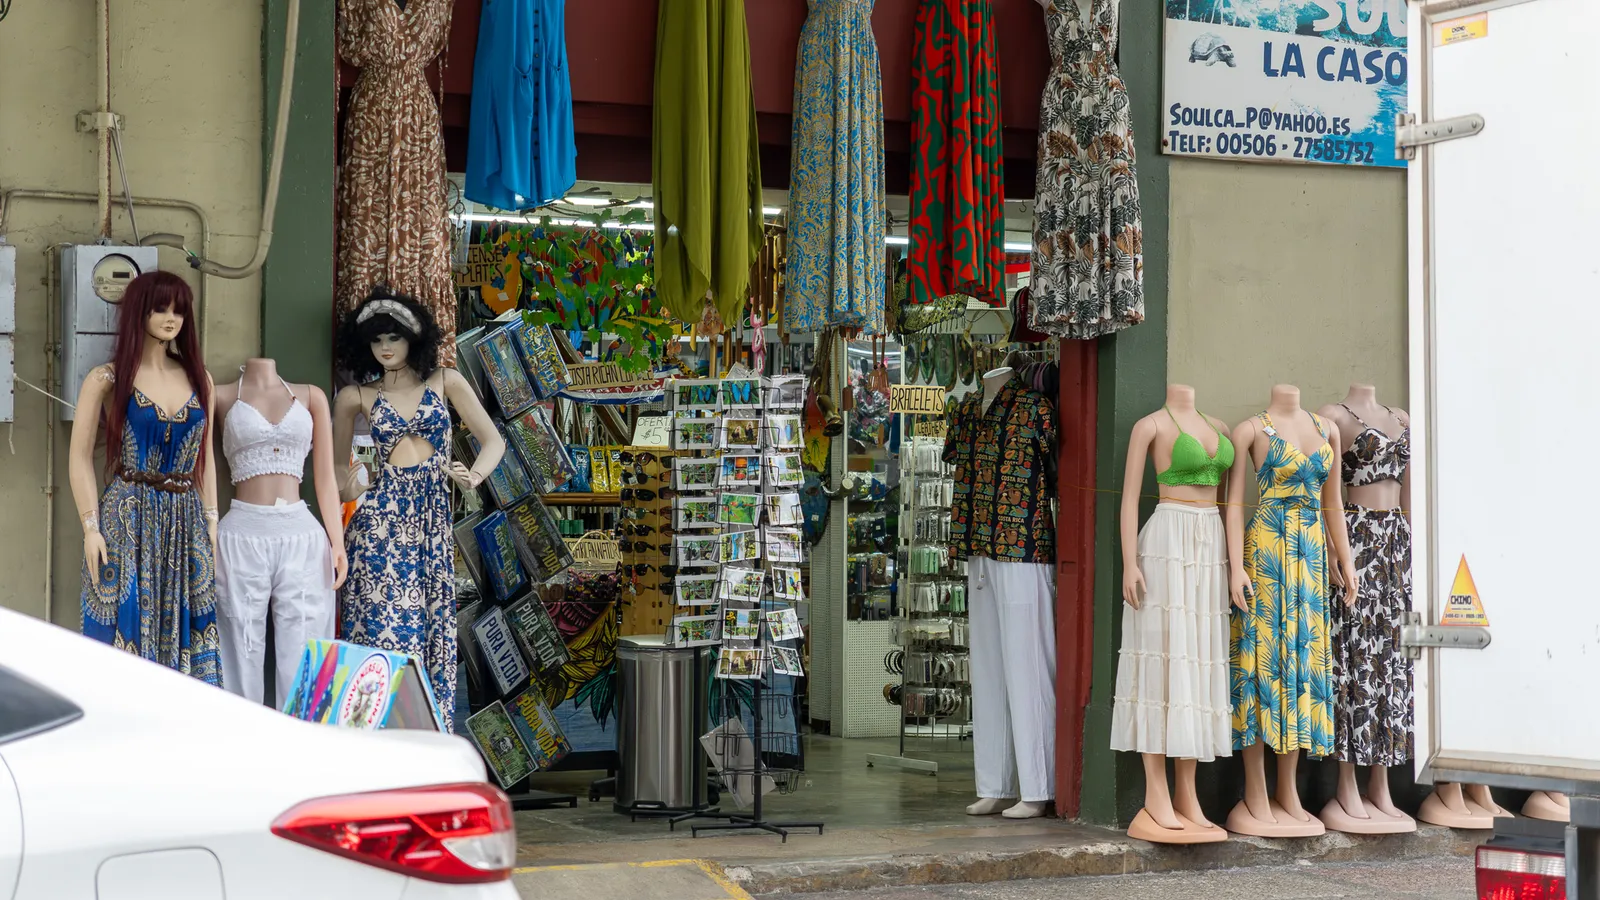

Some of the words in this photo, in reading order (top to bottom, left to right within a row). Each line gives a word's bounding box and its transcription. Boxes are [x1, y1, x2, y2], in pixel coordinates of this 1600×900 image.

[1264, 42, 1305, 78] LA
[1217, 132, 1276, 156] 00506
[1293, 136, 1374, 163] 27585752
[541, 360, 559, 387] RICA
[568, 366, 590, 386] COSTA
[592, 364, 619, 384] RICAN
[891, 387, 944, 411] BRACELETS
[493, 525, 508, 558] COSTA
[504, 560, 517, 586] RICA
[513, 503, 540, 537] PURA
[538, 544, 562, 576] VIDA
[482, 616, 503, 655] PURA
[496, 650, 522, 687] VIDA
[503, 628, 514, 646] COSTA
[511, 644, 520, 657] RICA
[516, 602, 542, 636] PURA
[534, 635, 559, 669] VIDA
[482, 641, 502, 680] CENTROAMERICA
[515, 695, 546, 732] PURA
[532, 726, 561, 759] VIDA
[540, 706, 552, 722] COSTA
